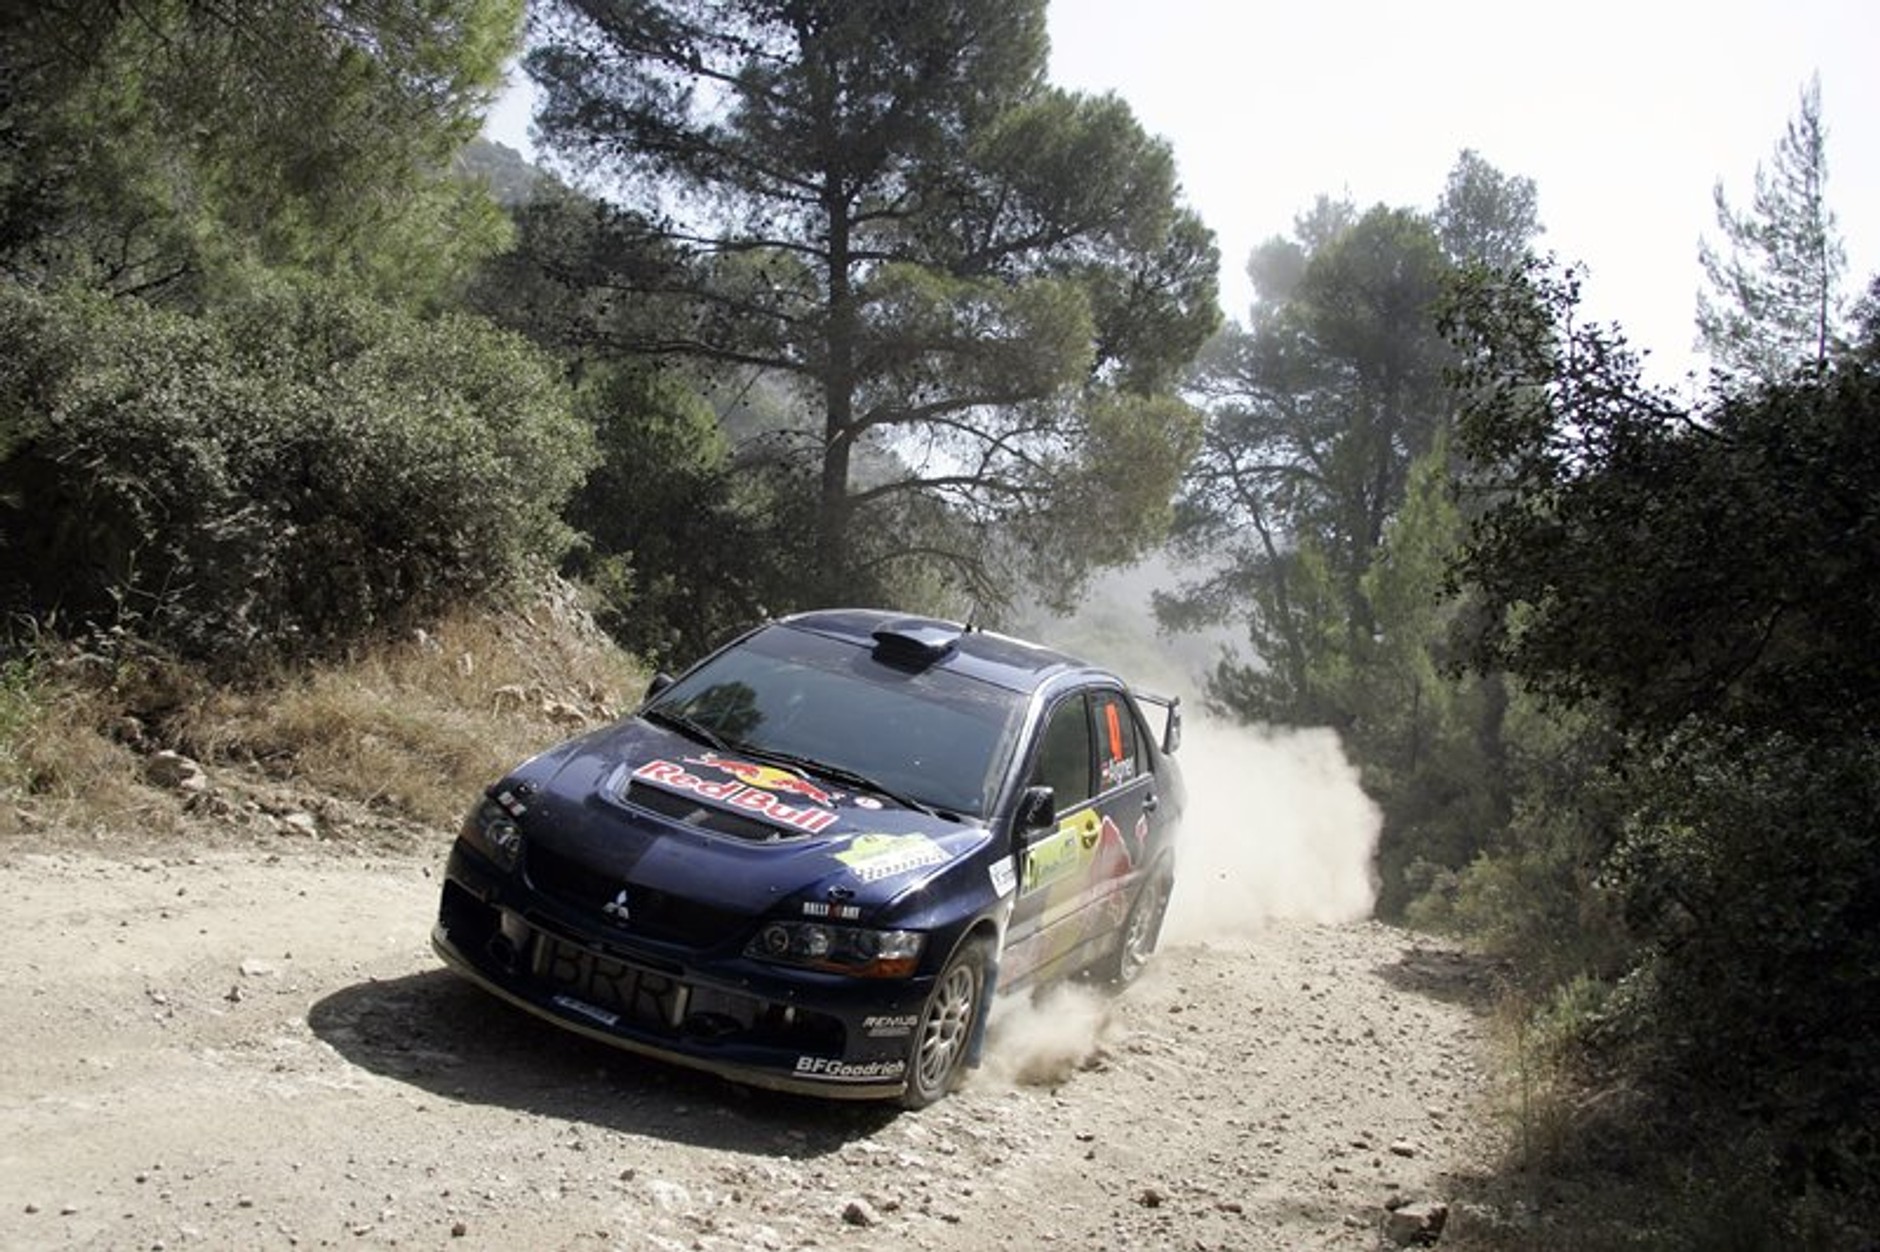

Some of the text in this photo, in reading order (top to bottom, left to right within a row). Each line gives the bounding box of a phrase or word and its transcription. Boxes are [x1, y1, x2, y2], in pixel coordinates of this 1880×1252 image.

[632, 759, 840, 834] Red Bull
[795, 1056, 906, 1076] BFGoodrich
